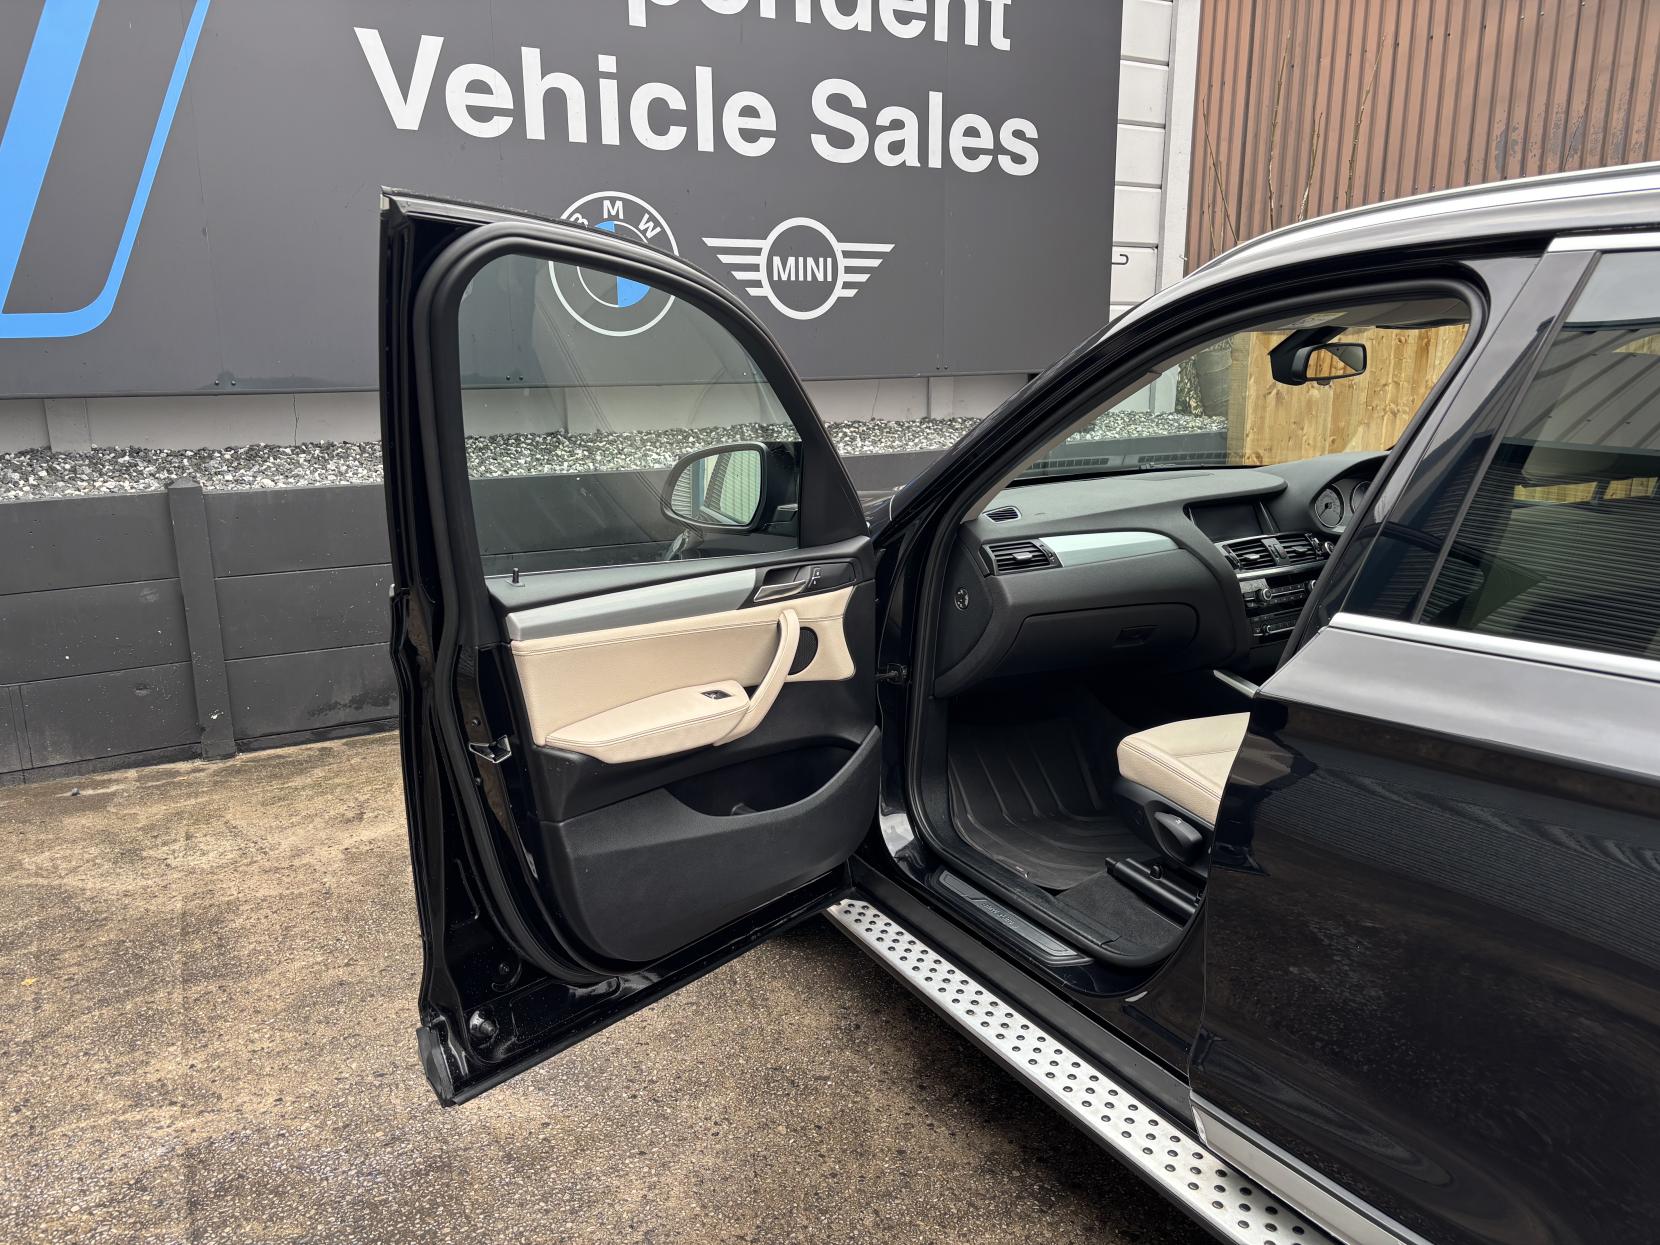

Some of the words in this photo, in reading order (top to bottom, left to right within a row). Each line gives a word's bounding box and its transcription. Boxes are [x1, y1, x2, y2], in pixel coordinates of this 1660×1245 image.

[354, 26, 777, 157] Vehicle
[811, 78, 1039, 176] Sales
[772, 255, 833, 282] MINI
